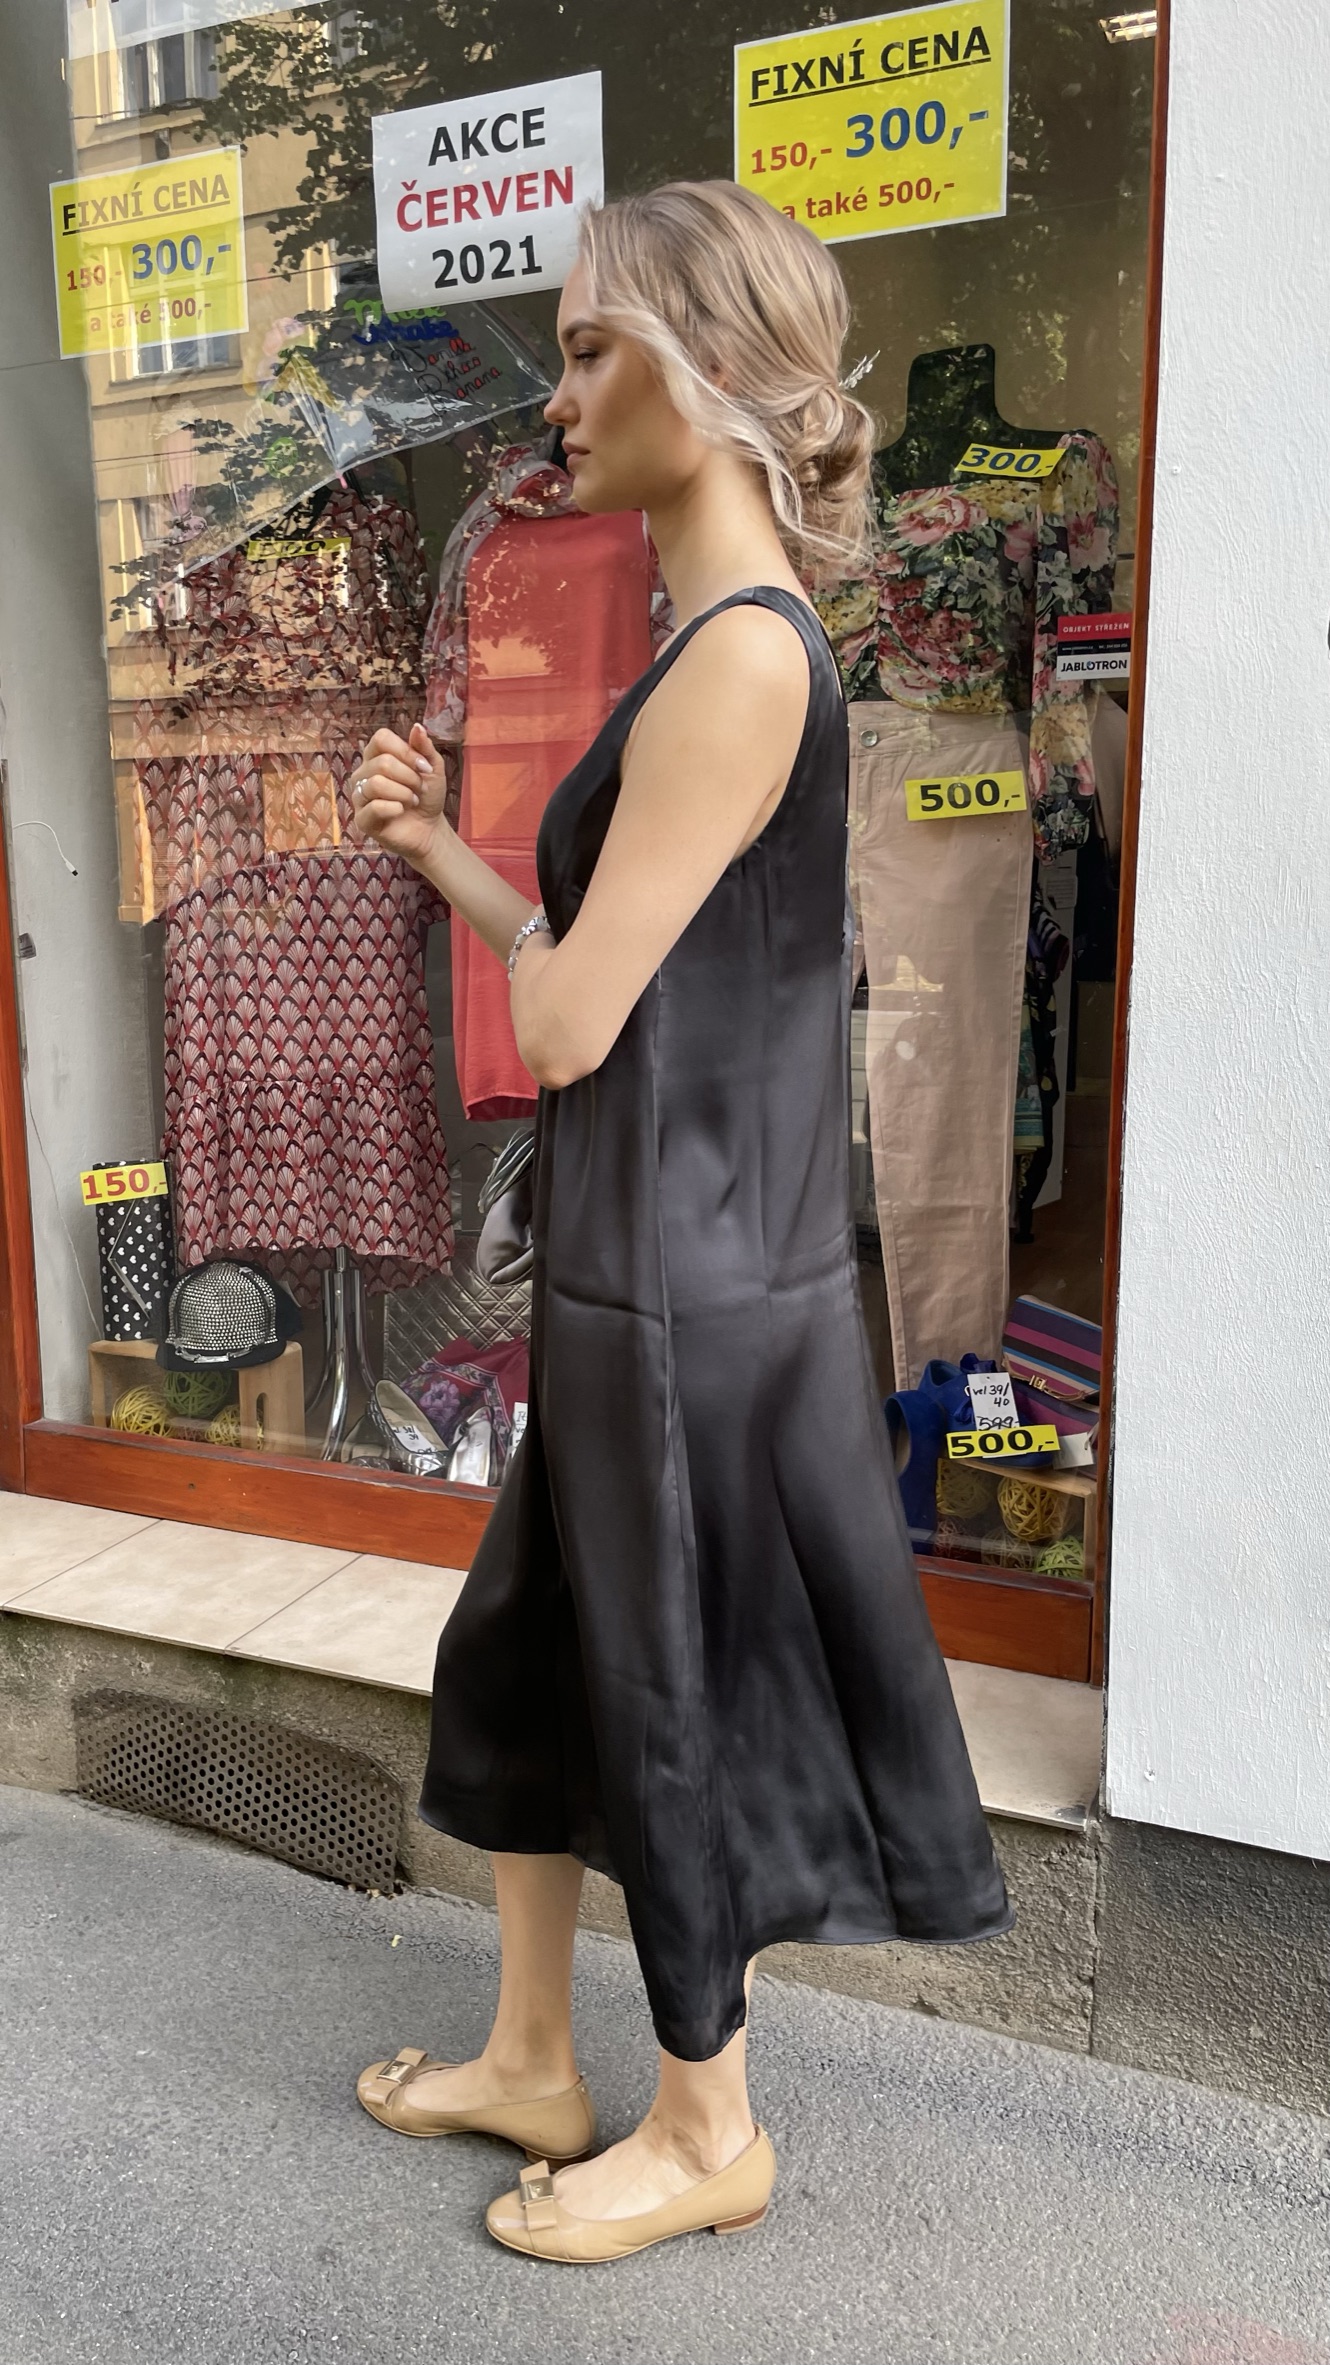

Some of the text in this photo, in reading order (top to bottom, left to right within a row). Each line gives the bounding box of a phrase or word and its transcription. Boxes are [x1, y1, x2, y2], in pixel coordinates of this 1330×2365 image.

[751, 26, 991, 100] FIXNÍ CENA
[428, 107, 546, 167] AKCE
[751, 100, 989, 175] 150,- 300,-
[62, 174, 230, 230] FIXNÍ CENA
[396, 165, 574, 232] ČERVEN
[806, 186, 868, 219] také
[879, 177, 955, 208] 500,-
[132, 234, 231, 280] 300,-
[432, 235, 543, 289] 2021
[90, 317, 101, 332] a
[961, 447, 1053, 475] 300,-
[1062, 625, 1092, 633] OBJEKT
[1061, 659, 1128, 672] JABLOTRON
[920, 779, 1021, 812] 500,-
[83, 1168, 166, 1200] 150,-
[972, 1385, 987, 1396] vel
[993, 1397, 1010, 1408] 40
[950, 1430, 1055, 1457] 500,-
